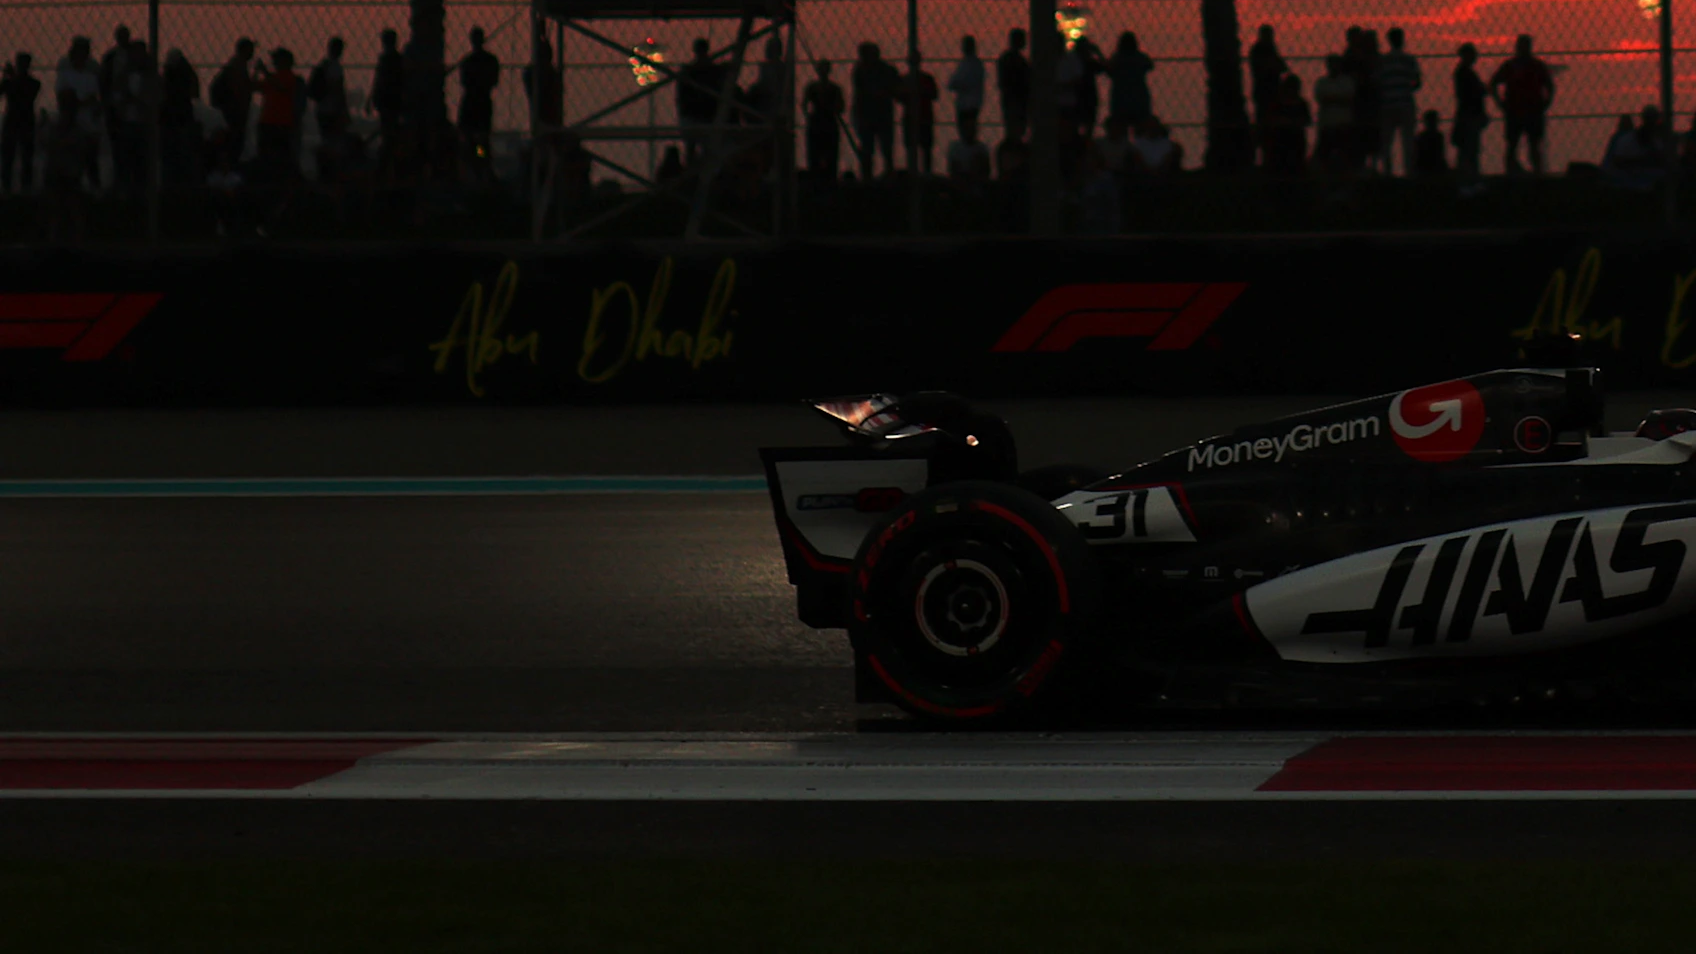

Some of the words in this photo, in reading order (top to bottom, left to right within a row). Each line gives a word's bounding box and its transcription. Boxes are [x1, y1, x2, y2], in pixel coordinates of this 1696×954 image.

[427, 259, 541, 398] Abu
[576, 254, 738, 384] Dhabi
[989, 281, 1251, 353] F1
[1511, 246, 1624, 359] Abu
[1187, 414, 1380, 473] MoneyGram
[1079, 490, 1149, 539] 31
